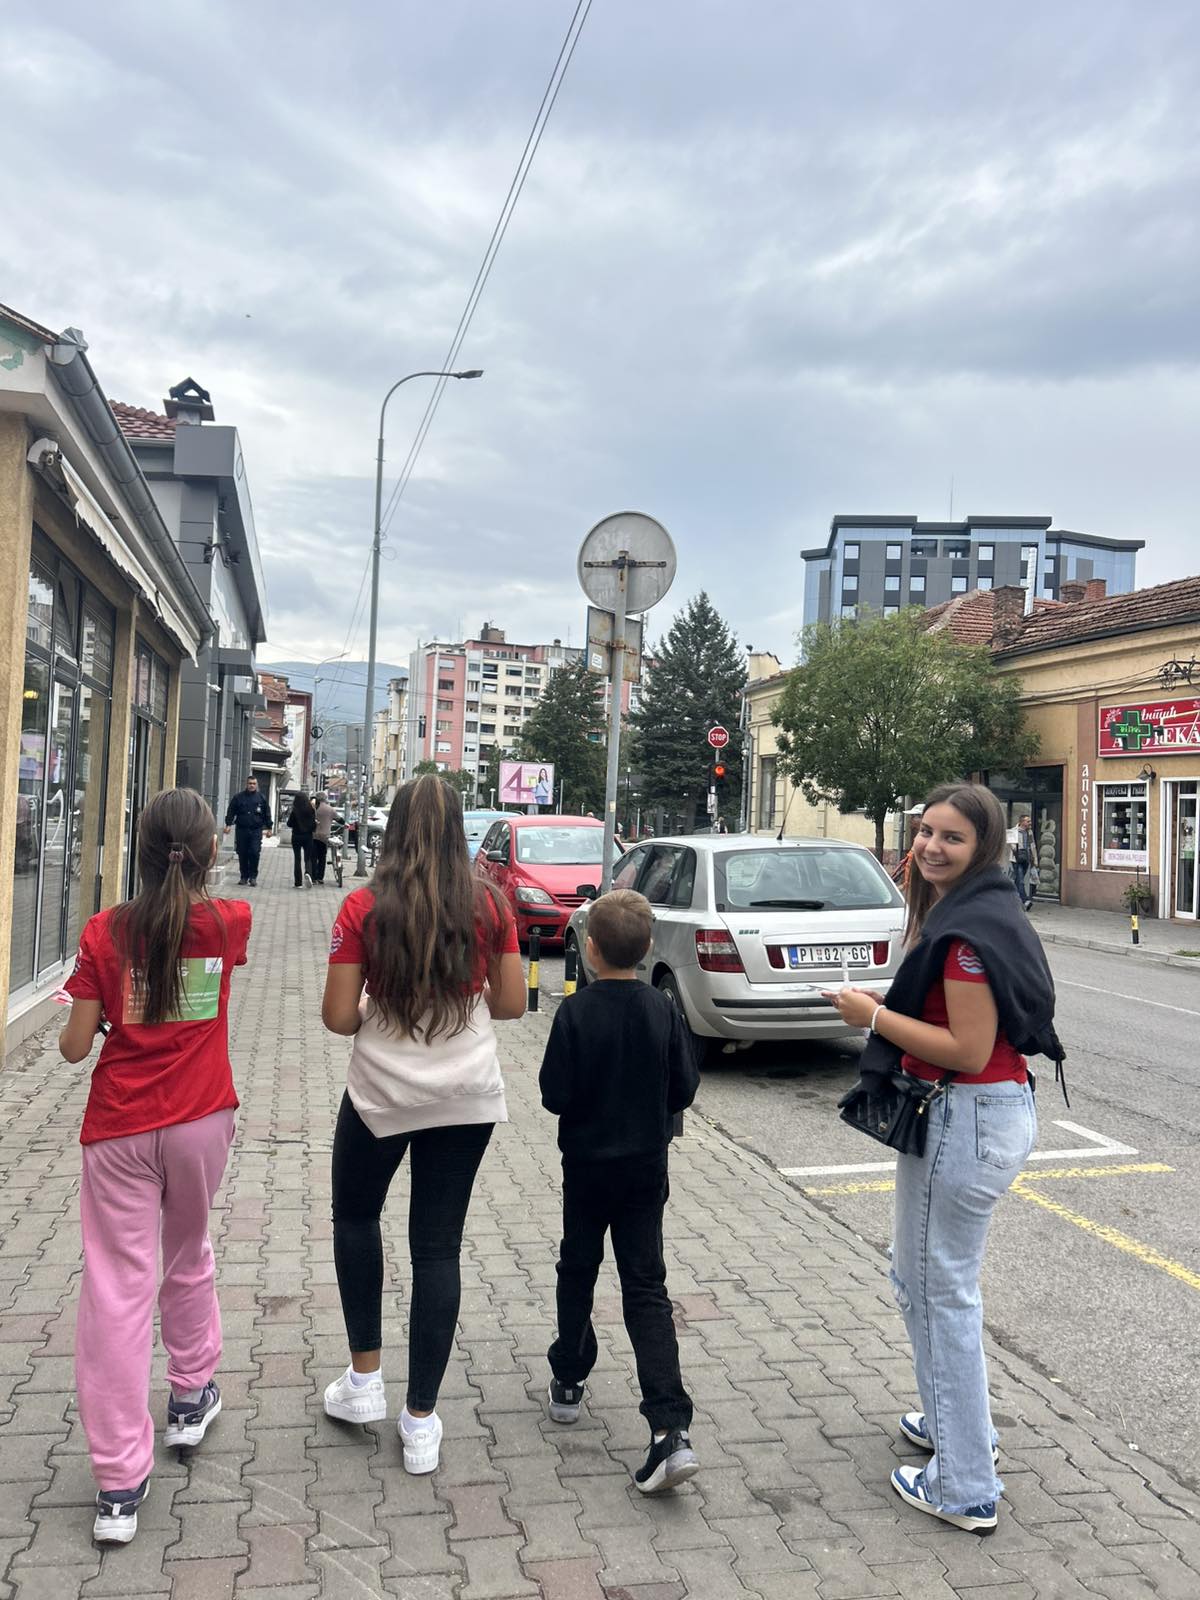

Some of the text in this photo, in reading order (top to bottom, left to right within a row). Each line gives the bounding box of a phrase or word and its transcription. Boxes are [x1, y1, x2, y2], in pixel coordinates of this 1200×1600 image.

[710, 733, 727, 741] STOP
[503, 766, 532, 800] 4
[800, 946, 867, 962] PI 02-GC
